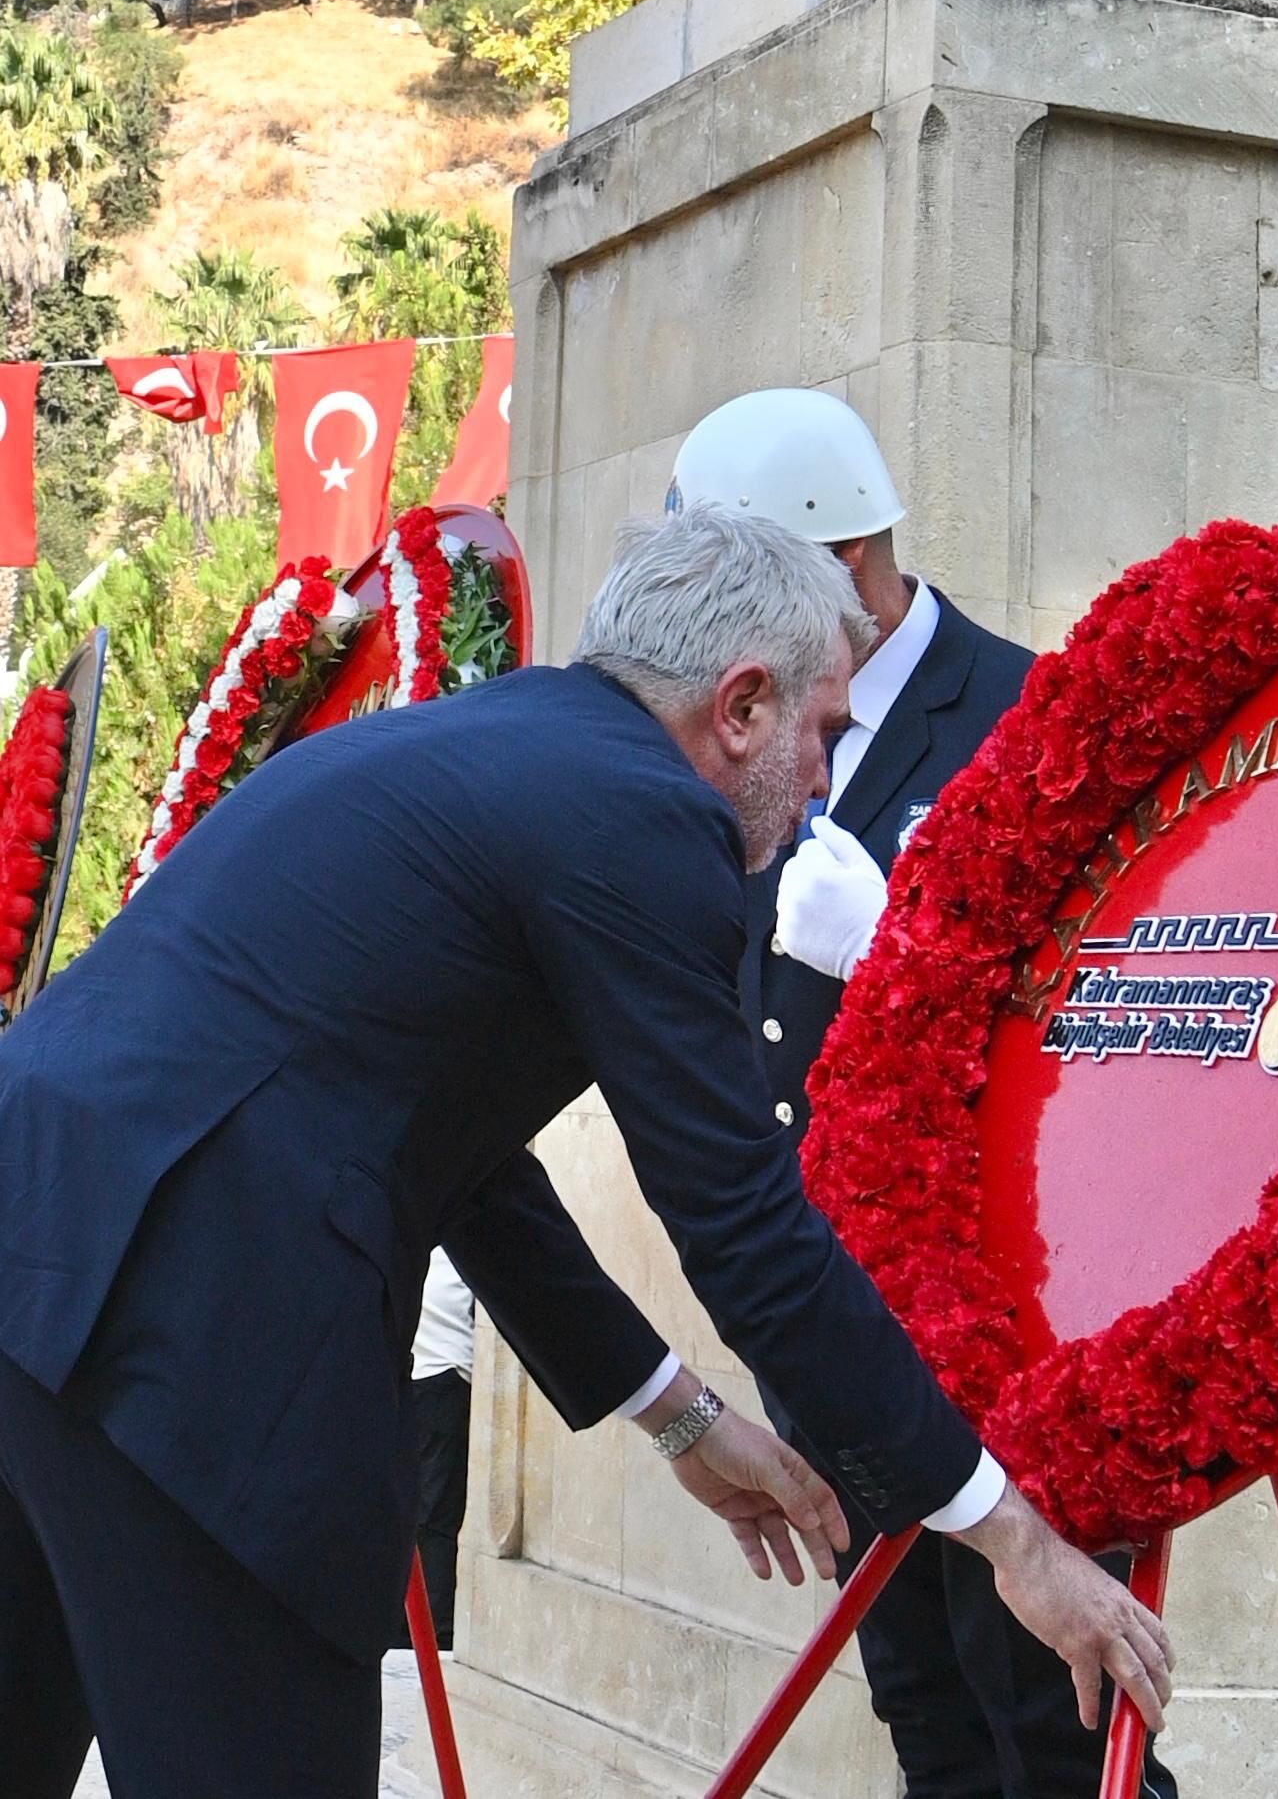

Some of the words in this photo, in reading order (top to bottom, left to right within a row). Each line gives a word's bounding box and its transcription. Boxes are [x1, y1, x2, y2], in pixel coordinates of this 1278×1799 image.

[1065, 967, 1272, 1015] Kahramanmaraş
[1042, 1012, 1148, 1060] Büyükşehir
[1148, 1013, 1257, 1062] Belediyesi
